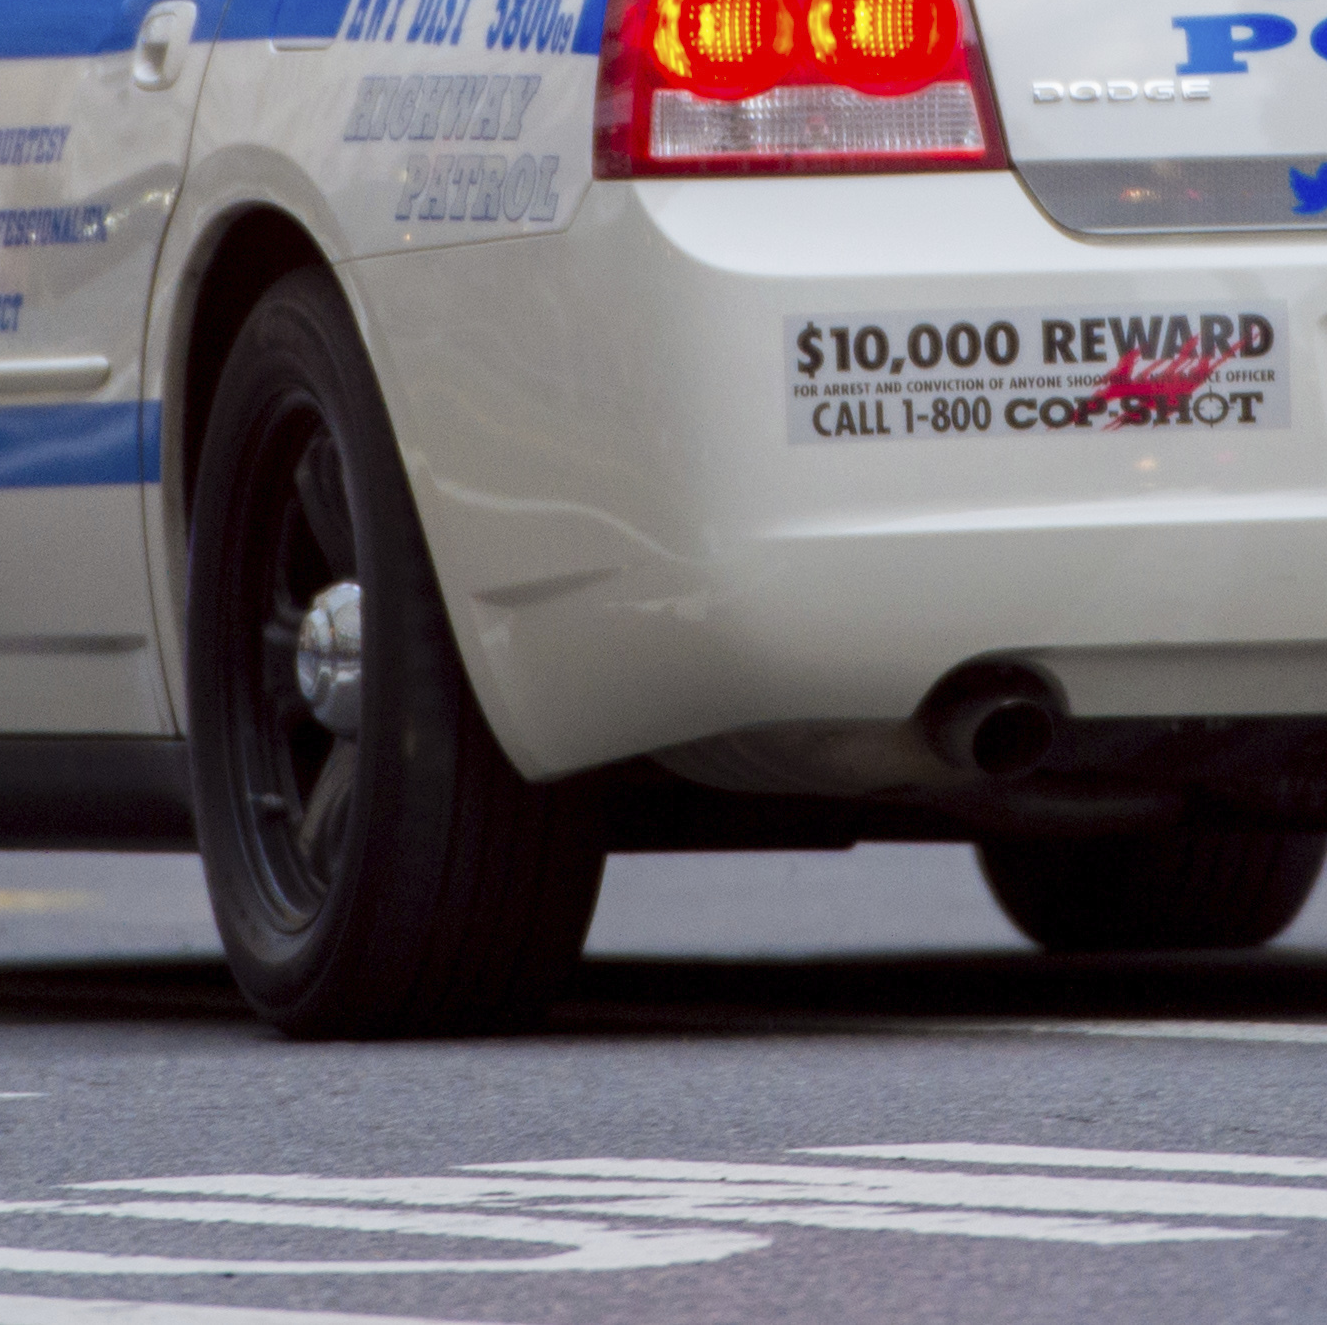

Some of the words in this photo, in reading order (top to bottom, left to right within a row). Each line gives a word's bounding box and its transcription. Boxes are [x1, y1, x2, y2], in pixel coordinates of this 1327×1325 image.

[343, 74, 543, 143] HIGHWAY
[1032, 78, 1211, 104] DODGE
[395, 152, 560, 222] PATROL
[796, 320, 1021, 379] $10,000
[1041, 312, 1275, 365] REWARD
[794, 384, 819, 397] FOR
[823, 382, 871, 396] ARREST
[875, 381, 902, 394] AND
[906, 378, 985, 393] CONVICTION
[989, 377, 1005, 391] OF
[1009, 375, 1063, 389] ANYONE
[1225, 369, 1276, 383] OFFICER
[812, 399, 891, 437] CALL
[902, 395, 992, 433] 1-800
